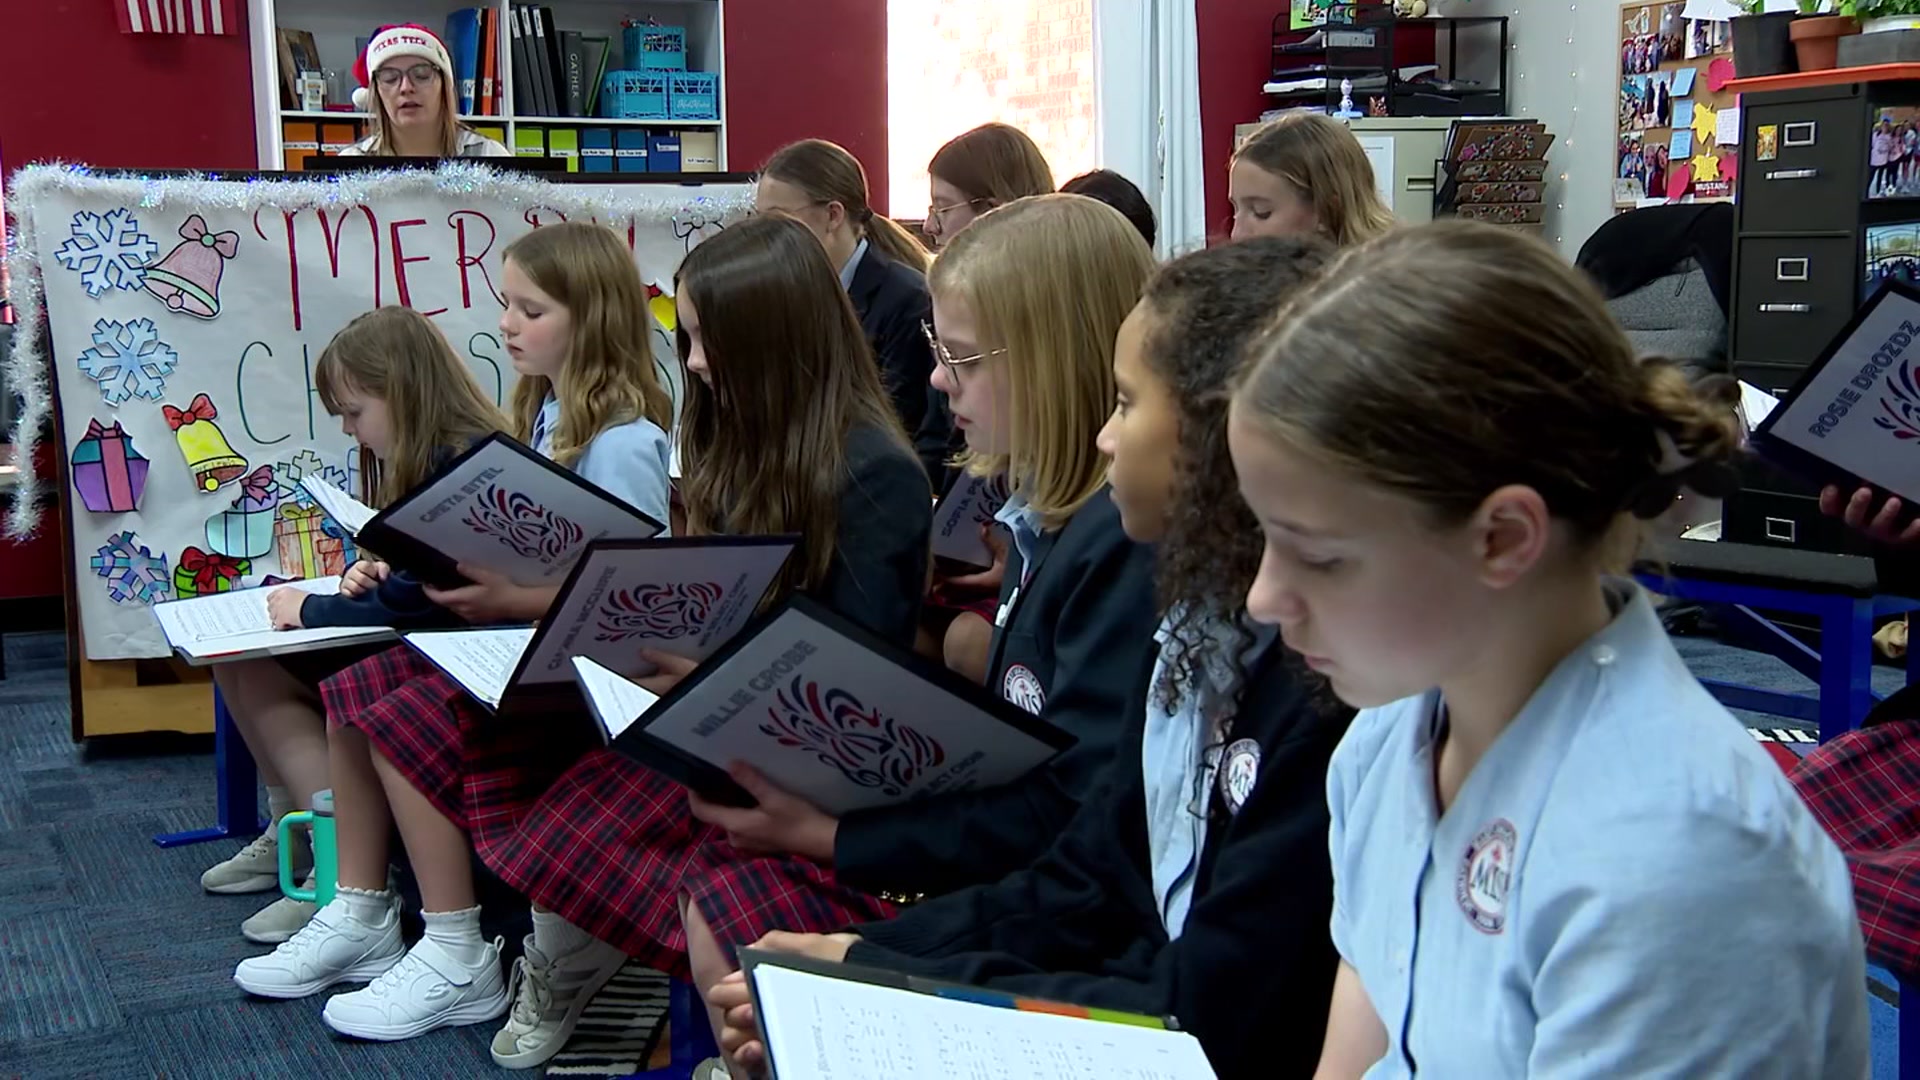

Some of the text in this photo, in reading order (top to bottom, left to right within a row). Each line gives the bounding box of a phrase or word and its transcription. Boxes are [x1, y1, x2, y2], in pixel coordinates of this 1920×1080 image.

[570, 53, 580, 98] GATHER
[1808, 319, 1920, 438] ROSIE DROZDZ
